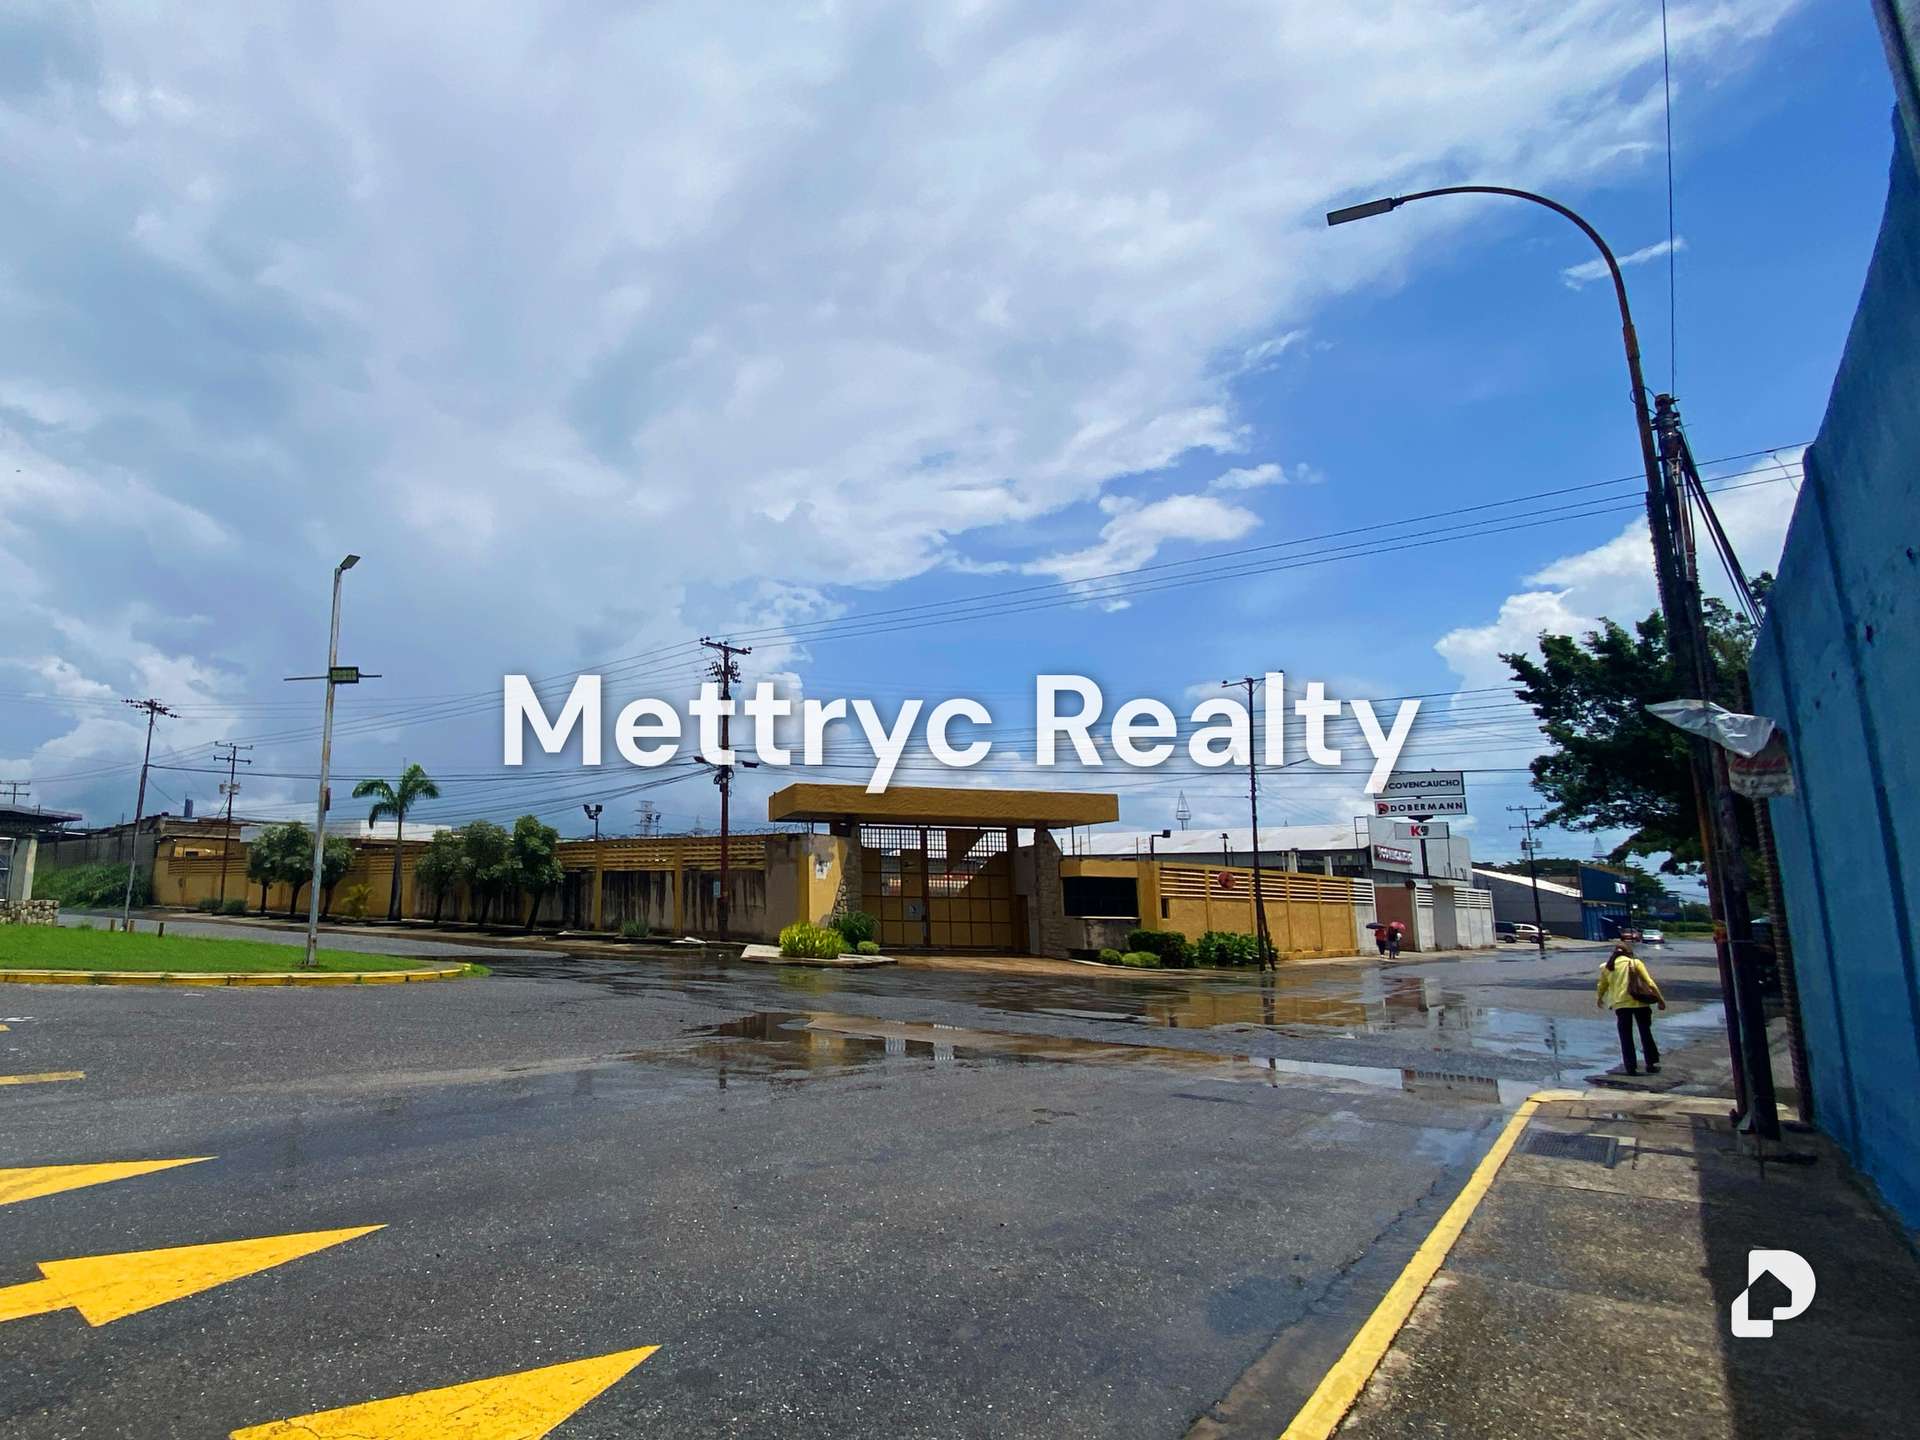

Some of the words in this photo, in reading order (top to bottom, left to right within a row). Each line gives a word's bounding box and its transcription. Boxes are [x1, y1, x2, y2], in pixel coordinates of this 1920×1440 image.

[1388, 779, 1460, 790] COVENCAUCHO
[1390, 802, 1463, 812] DOBERMANN
[1410, 825, 1430, 837] K9
